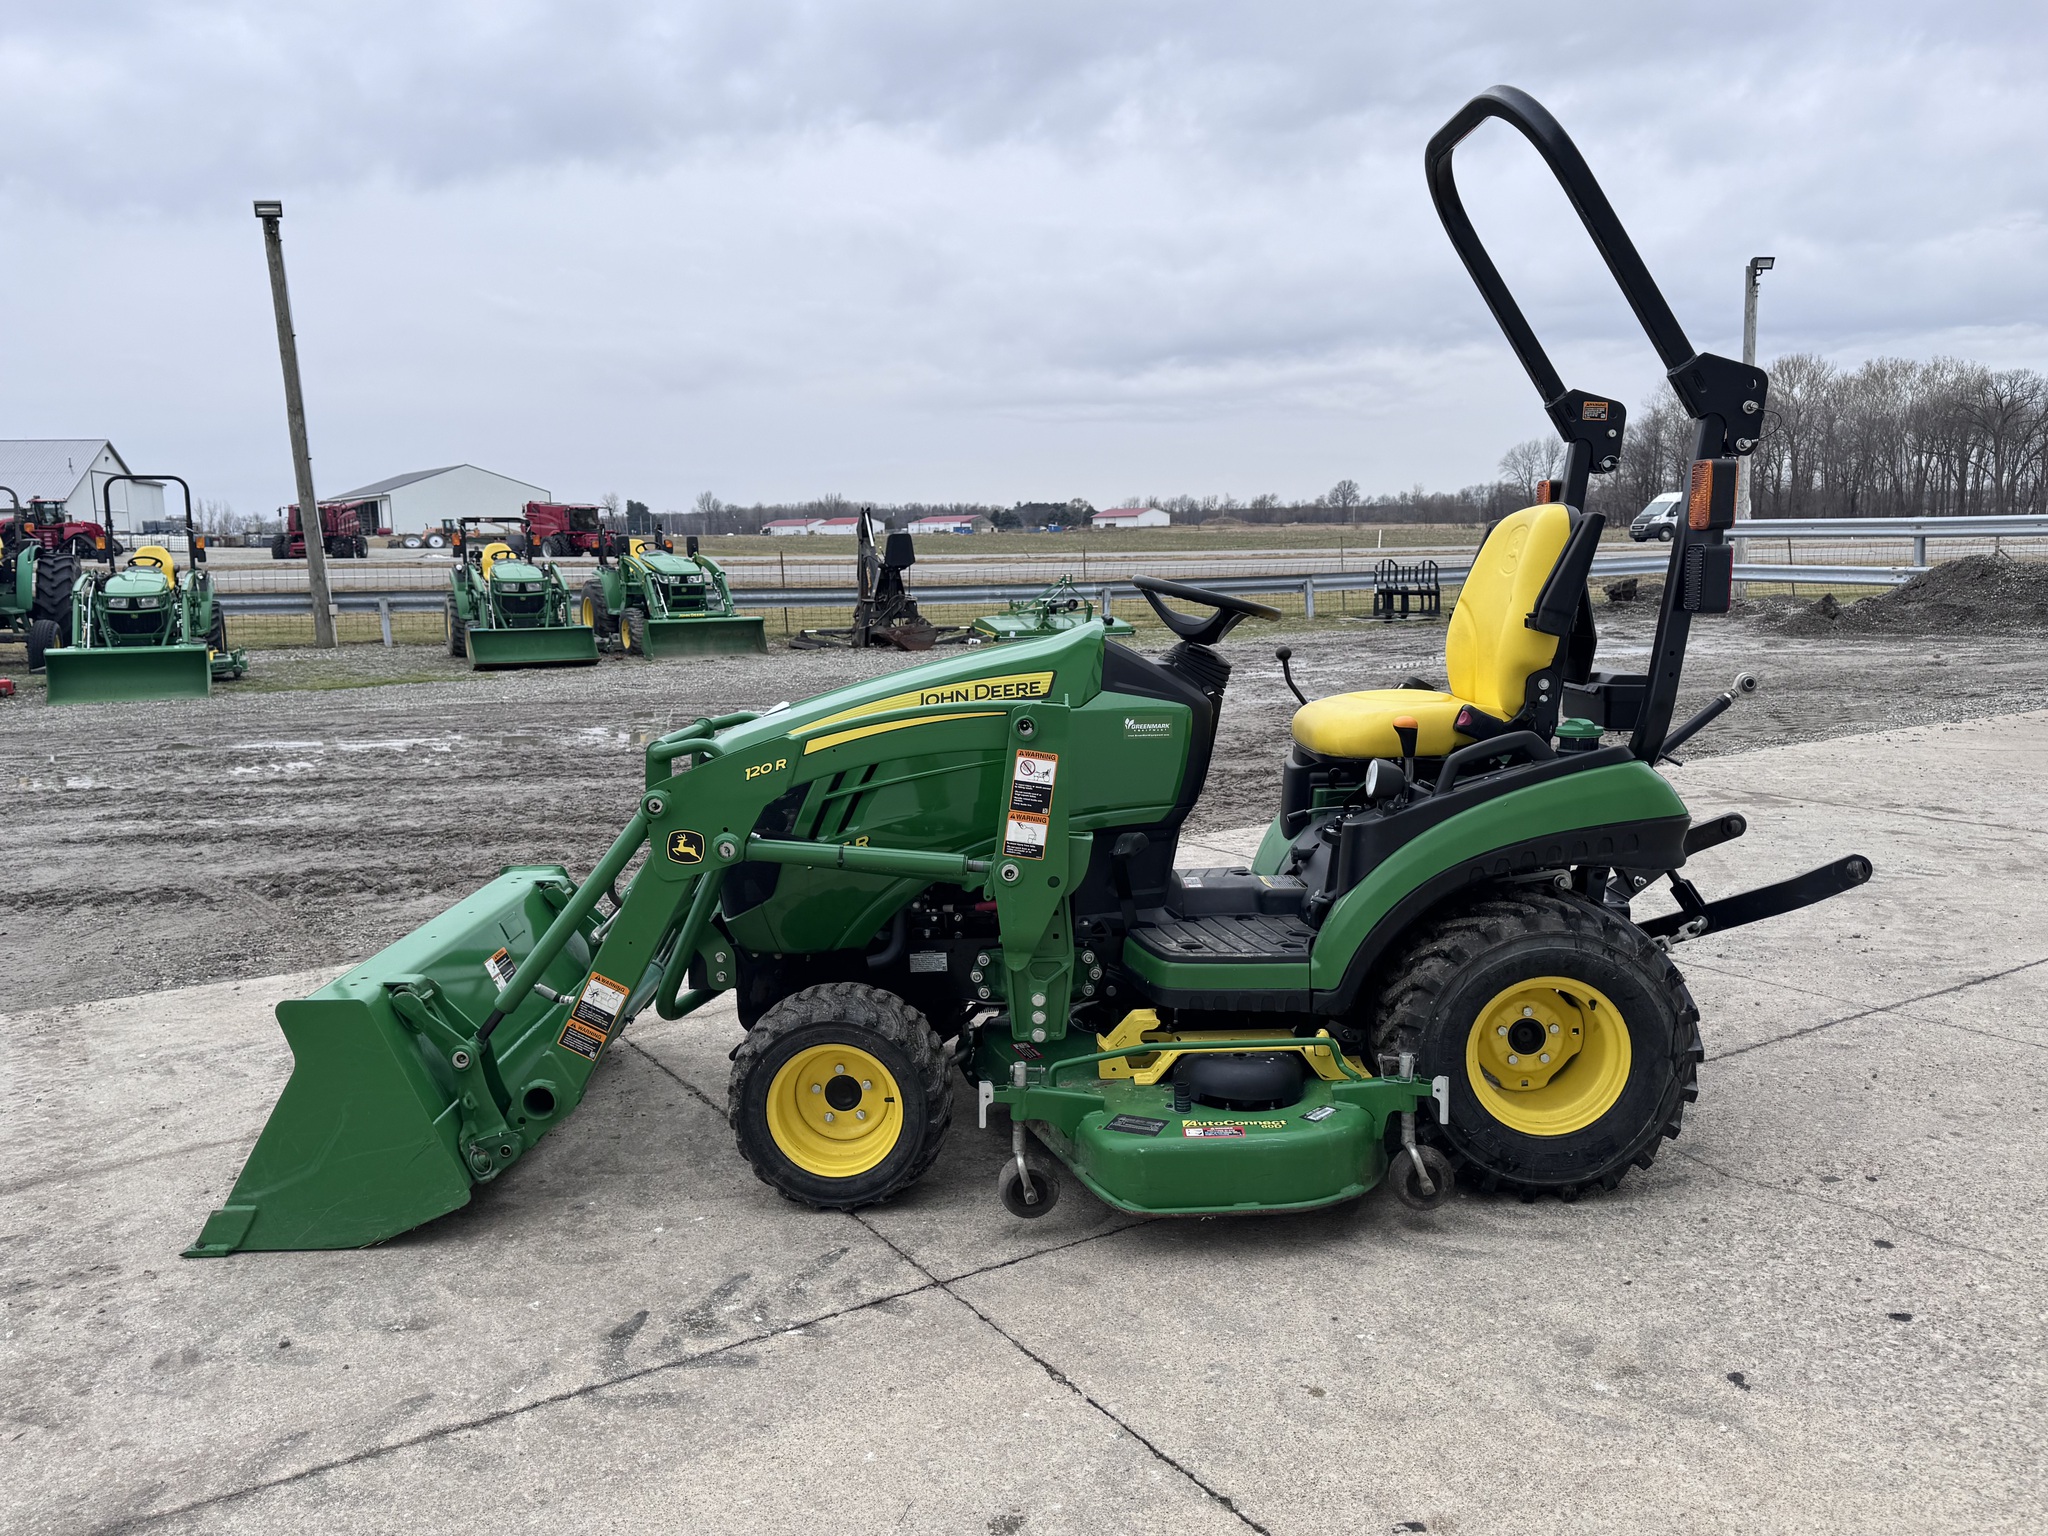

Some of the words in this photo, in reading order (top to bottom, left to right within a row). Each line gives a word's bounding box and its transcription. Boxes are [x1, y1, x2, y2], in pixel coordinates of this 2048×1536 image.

[920, 689, 969, 706] JOHN
[974, 681, 1041, 701] DEERE
[1025, 751, 1056, 761] WARNING
[745, 762, 774, 781] 120
[775, 758, 788, 771] R
[1016, 813, 1047, 824] WARNING
[601, 977, 626, 993] WARNING
[577, 1026, 603, 1040] WARNING
[1184, 1119, 1287, 1127] AutoConnect
